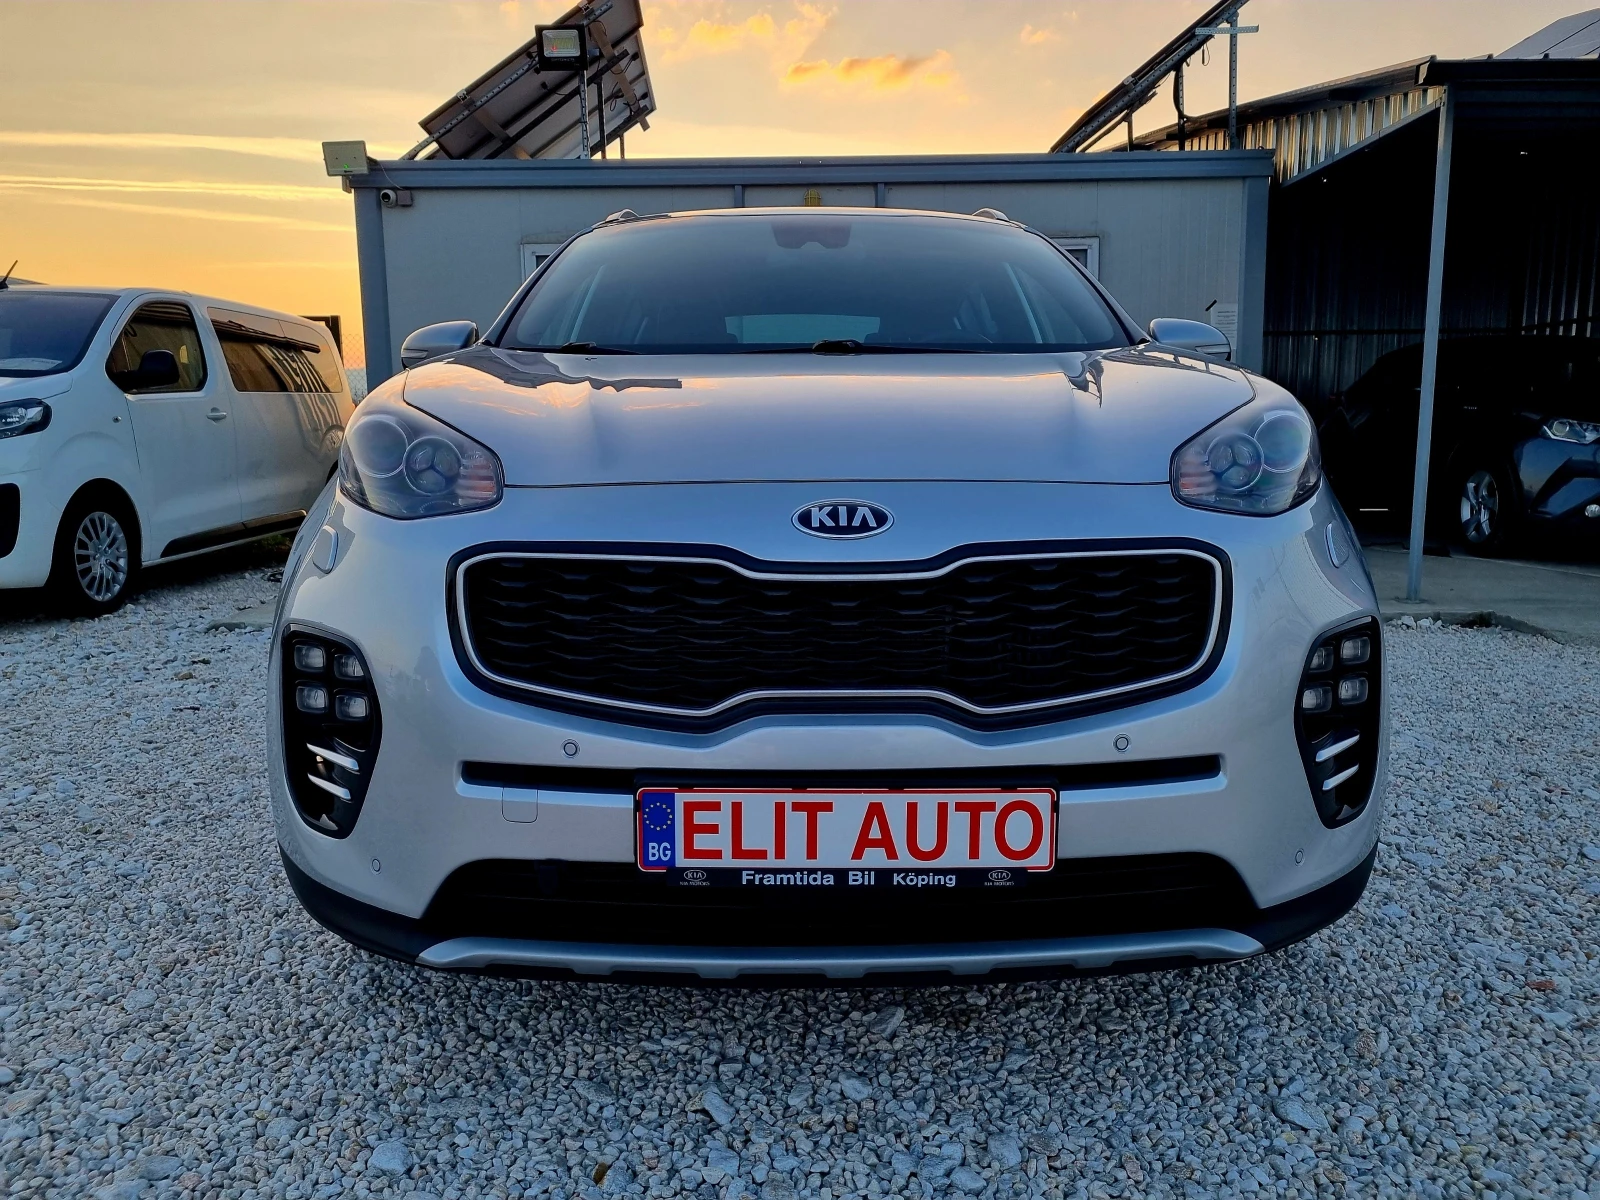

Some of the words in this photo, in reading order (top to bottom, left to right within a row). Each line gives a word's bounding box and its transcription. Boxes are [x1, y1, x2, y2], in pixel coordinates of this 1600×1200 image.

[810, 506, 877, 527] KIA
[683, 801, 834, 860] ELIT
[850, 799, 1044, 861] AUTO
[648, 842, 671, 861] BG
[742, 871, 834, 885] Framtida
[848, 871, 875, 885] Bil
[893, 873, 956, 887] Köping
